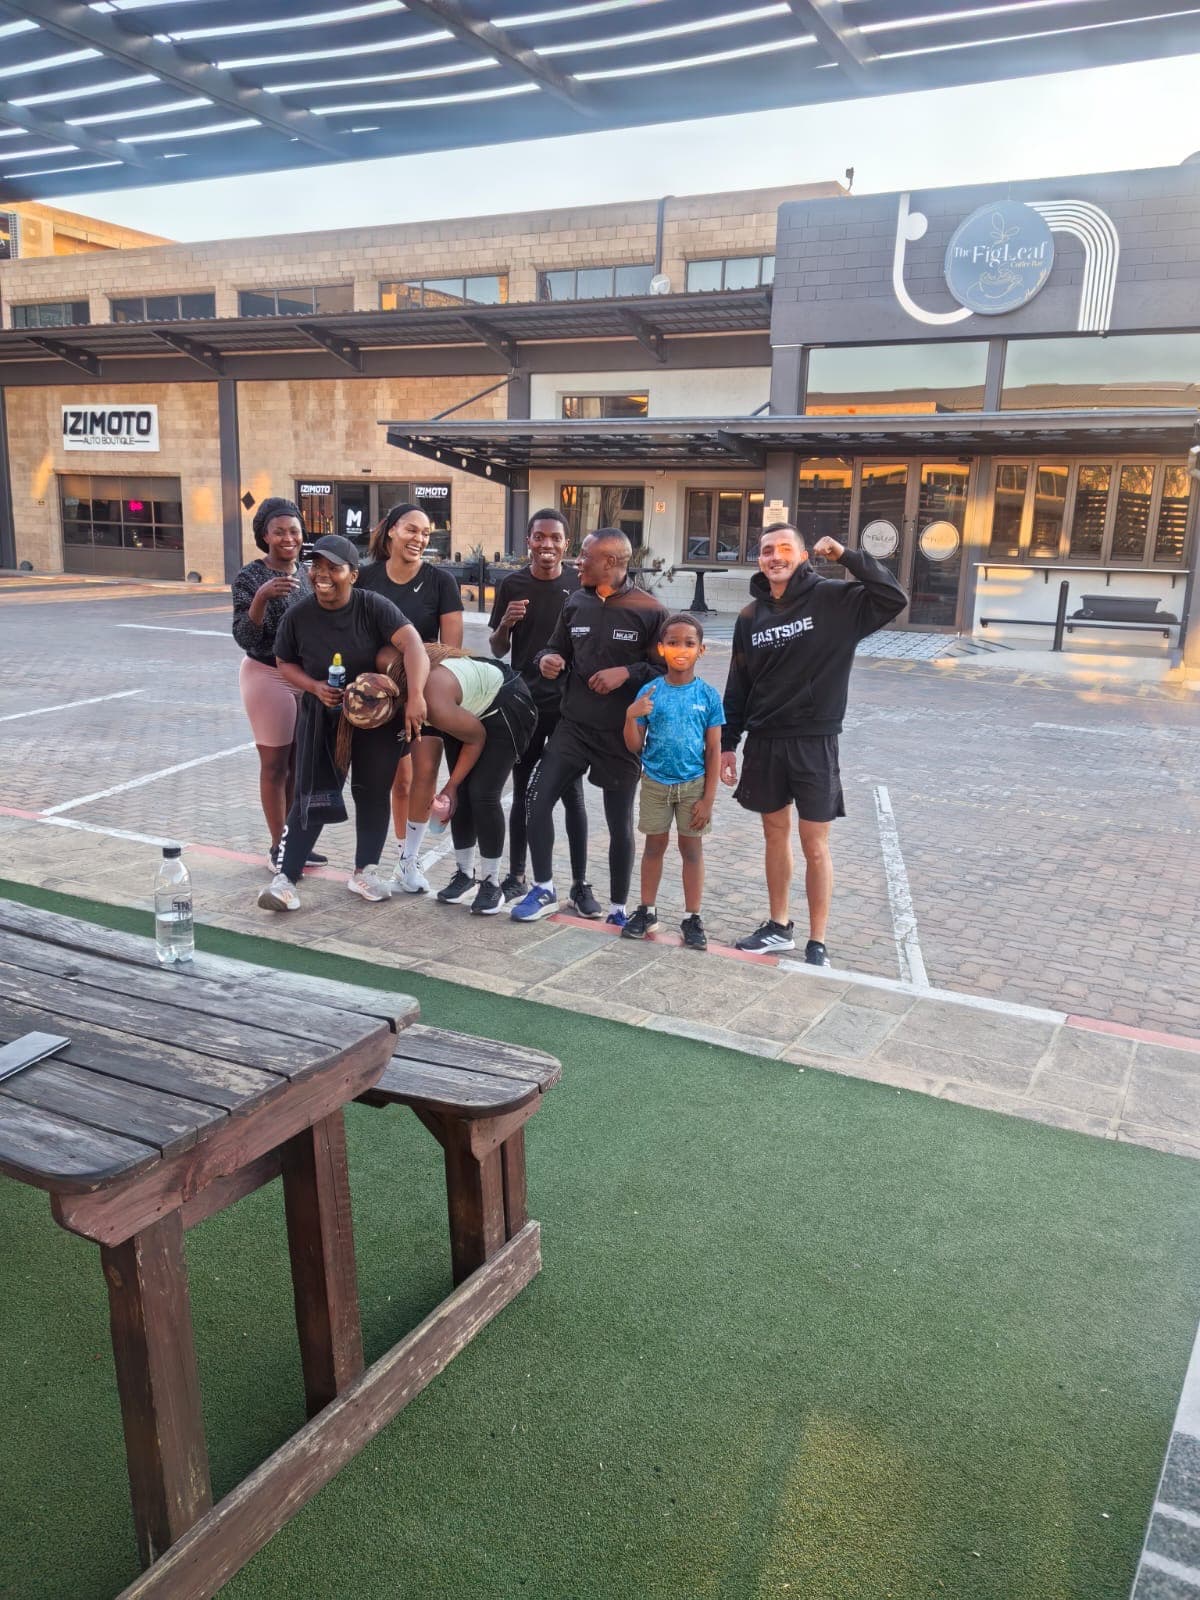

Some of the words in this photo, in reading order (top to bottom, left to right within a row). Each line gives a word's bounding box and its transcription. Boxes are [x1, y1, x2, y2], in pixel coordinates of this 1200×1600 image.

[973, 241, 1048, 267] FigLeaf
[63, 411, 152, 436] IZIMOTO
[83, 437, 101, 445] AUTO
[102, 437, 135, 445] BOUTIQUE
[300, 484, 331, 494] IZIMOTO
[415, 486, 448, 496] IZIMOTO
[346, 508, 362, 528] M
[751, 616, 814, 647] EASTSIDE
